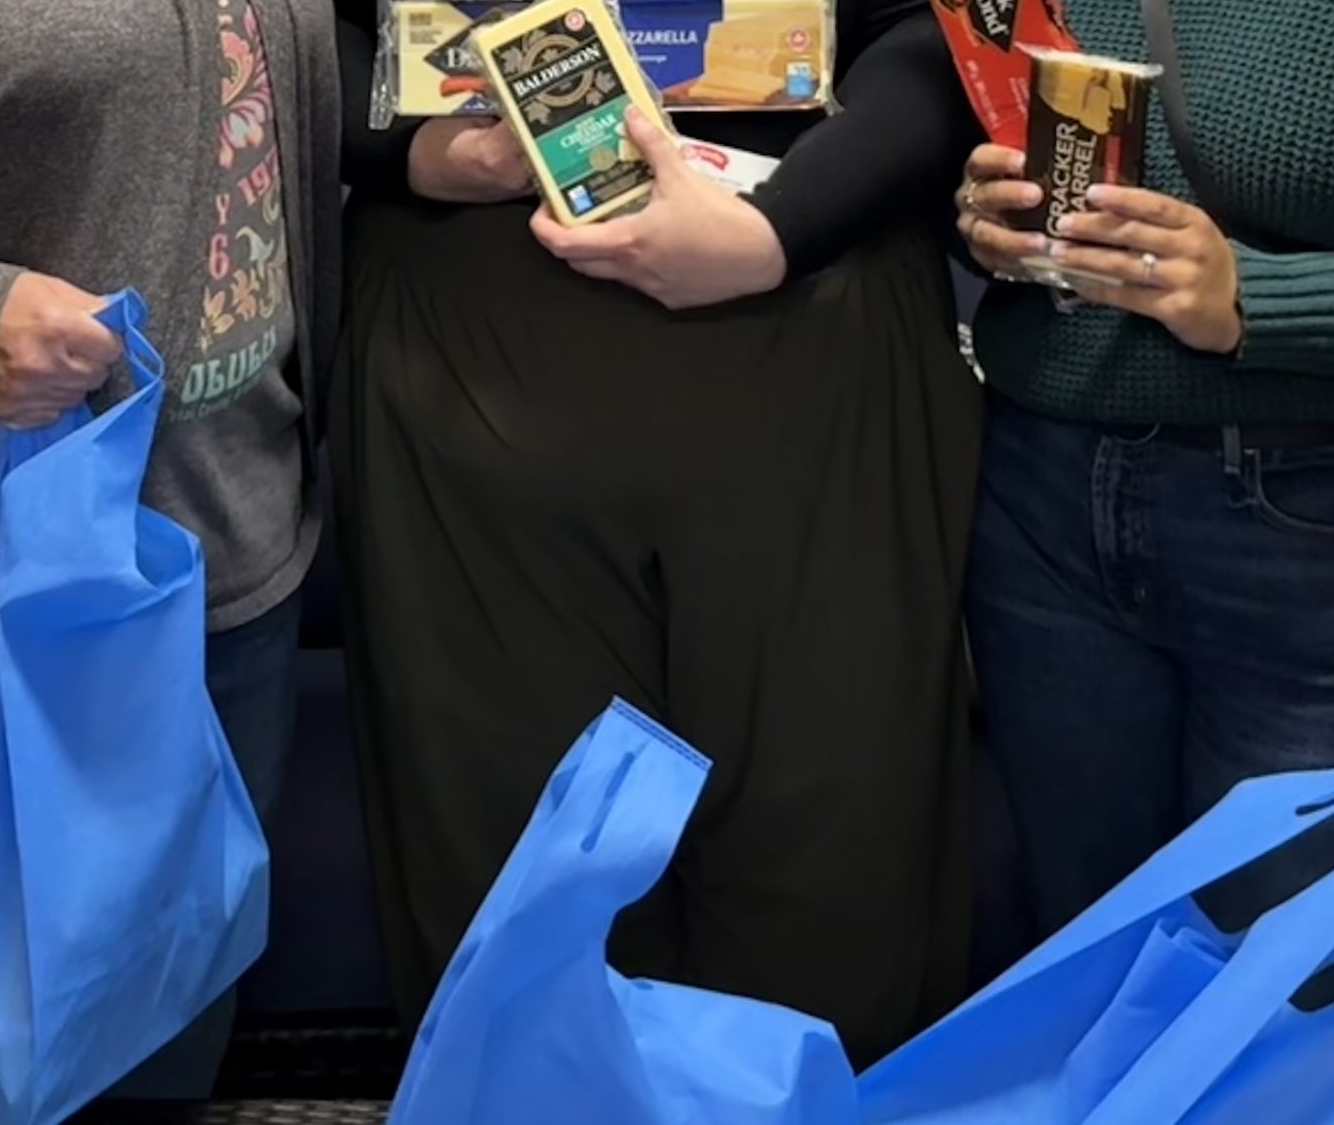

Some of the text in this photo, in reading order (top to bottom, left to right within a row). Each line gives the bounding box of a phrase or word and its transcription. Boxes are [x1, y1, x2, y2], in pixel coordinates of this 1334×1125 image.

[513, 42, 601, 98] BALDERSON
[627, 29, 698, 44] ZZARELLA
[1047, 121, 1078, 237] CRACKER
[1070, 135, 1097, 213] ARREL
